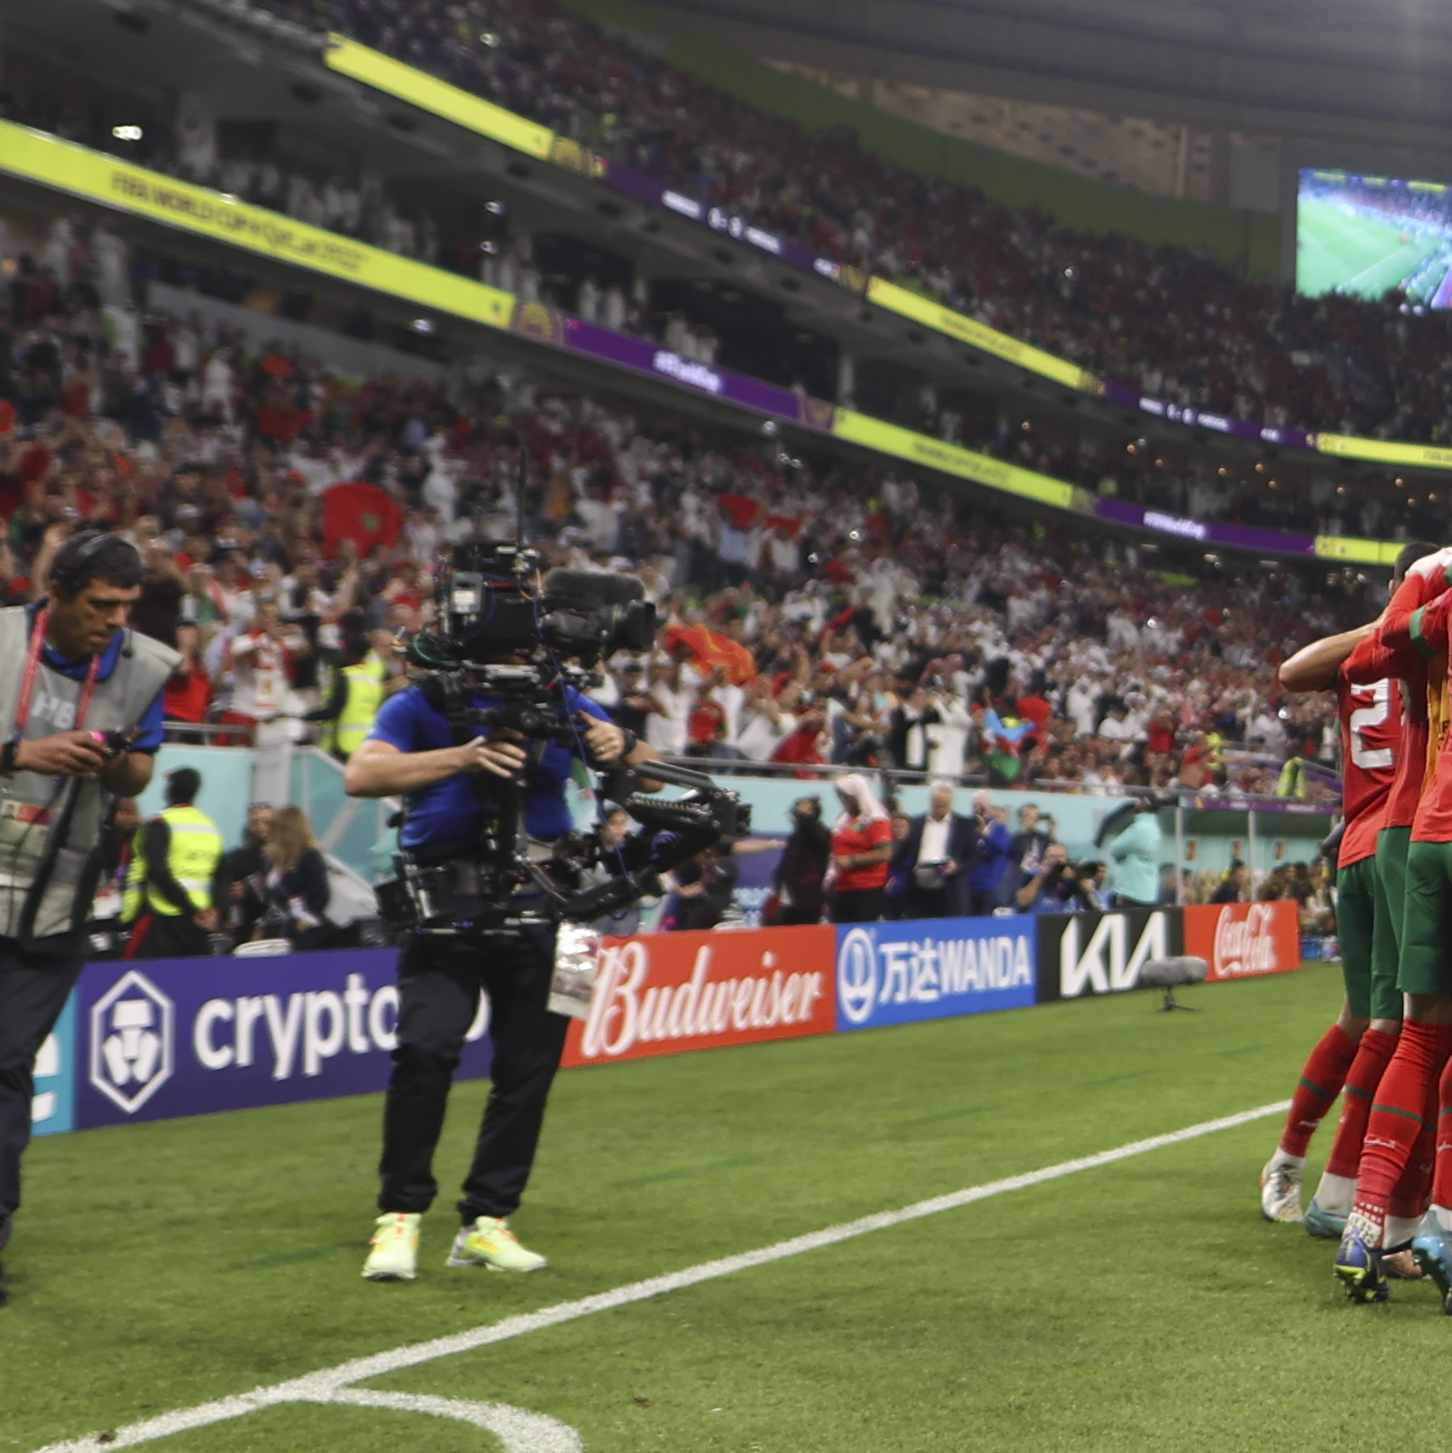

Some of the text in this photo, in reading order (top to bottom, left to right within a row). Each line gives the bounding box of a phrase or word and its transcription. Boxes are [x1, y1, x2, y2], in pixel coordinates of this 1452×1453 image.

[1350, 677, 1395, 770] 2
[580, 940, 823, 1059] Budweiser
[938, 934, 1032, 995] WANDA
